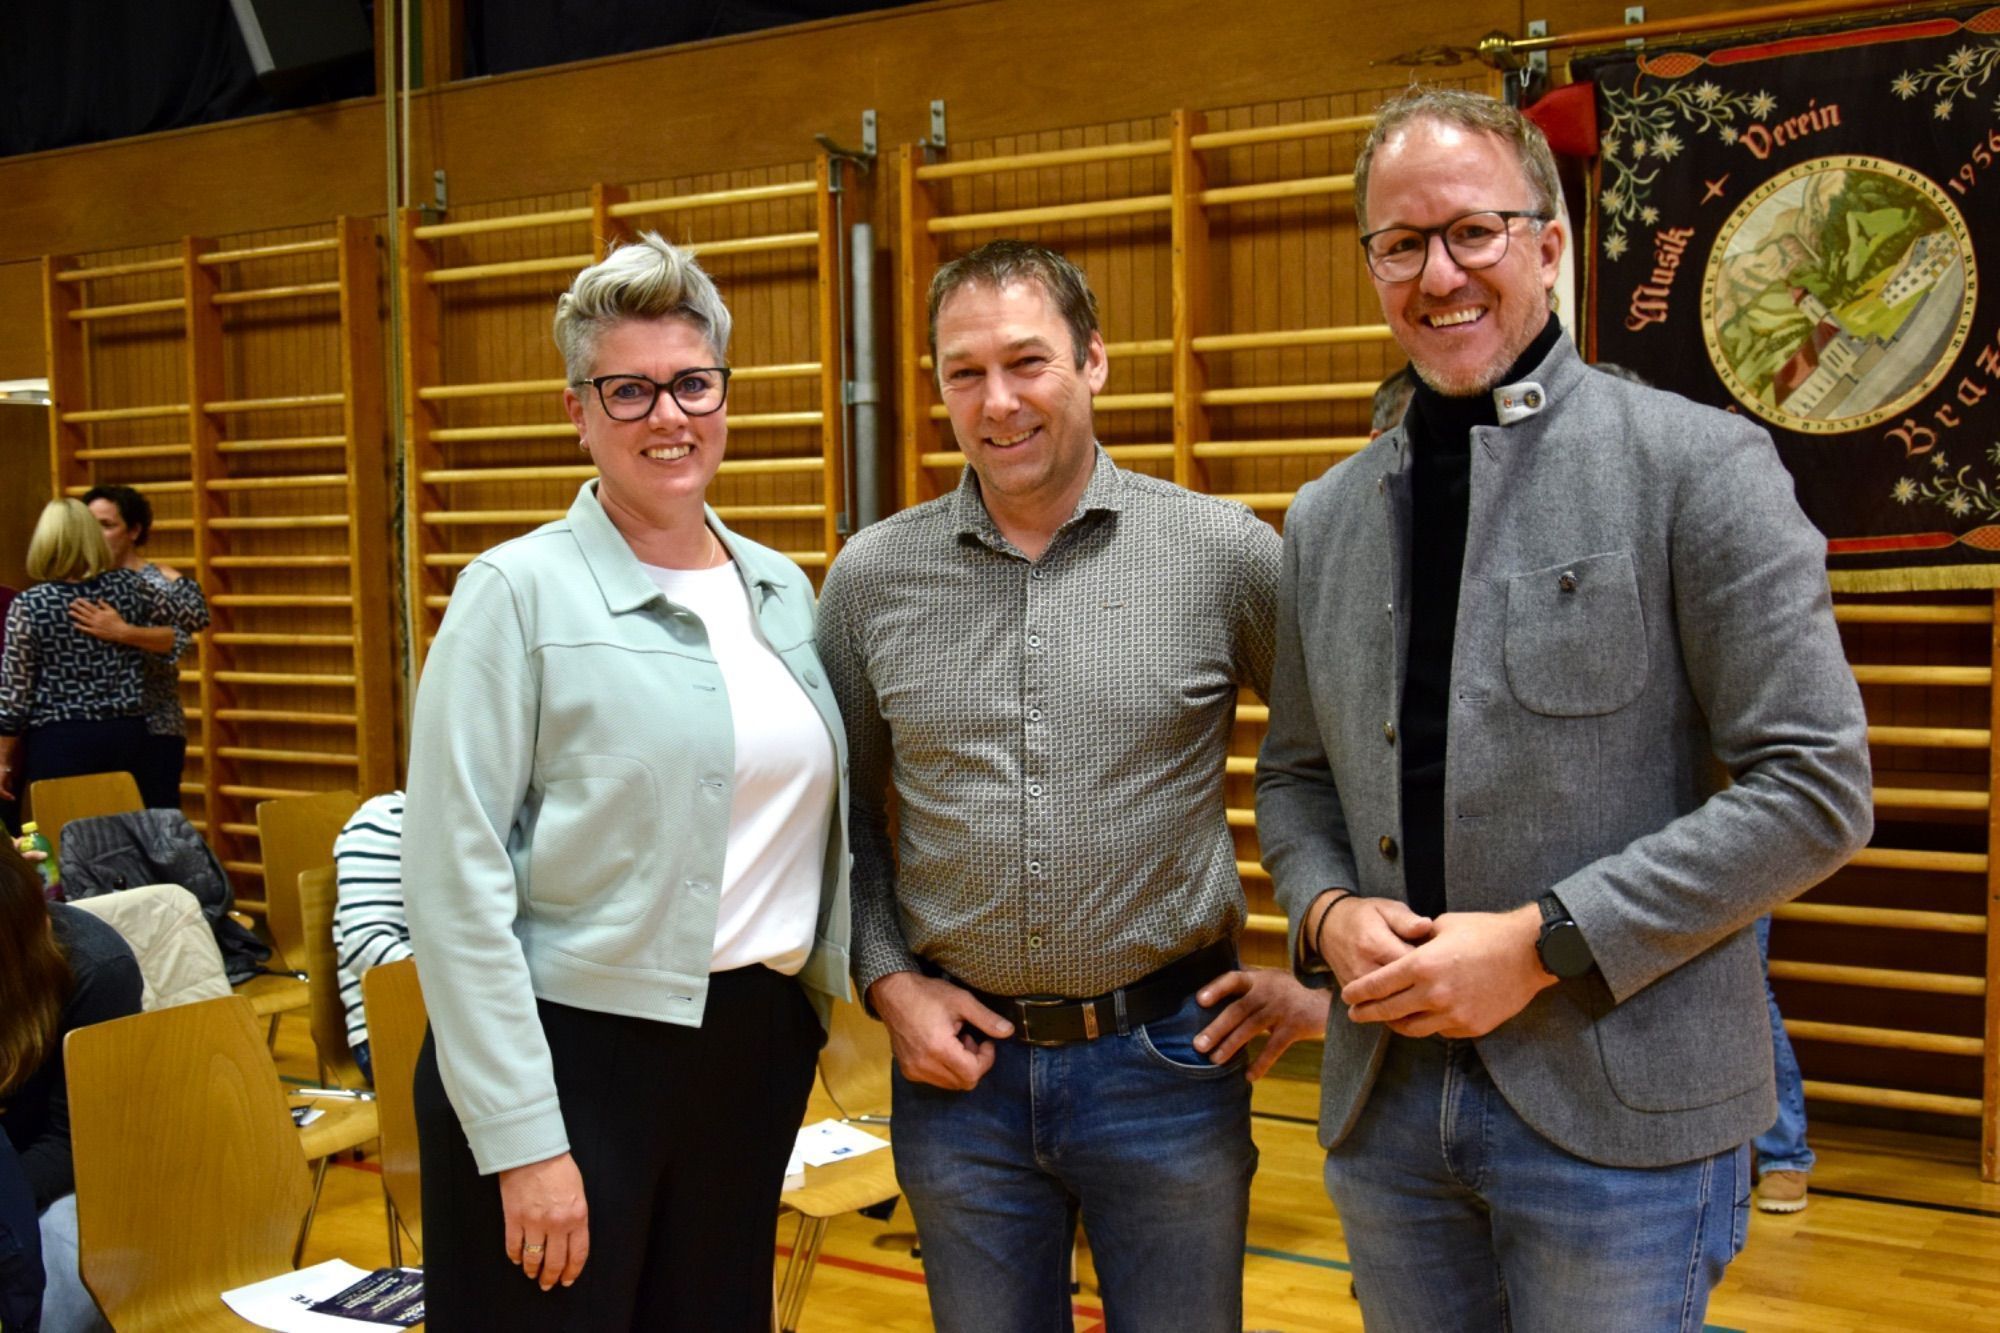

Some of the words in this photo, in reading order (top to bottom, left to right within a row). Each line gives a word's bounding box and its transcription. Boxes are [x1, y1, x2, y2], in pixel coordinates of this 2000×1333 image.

[1789, 159, 1830, 176] UND
[1948, 128, 2000, 195] 1956
[1625, 225, 1696, 332] Musik
[1739, 99, 1841, 160] Verein
[1711, 182, 1777, 265] DIETRICH
[1896, 167, 1966, 240] FRANZISKA
[1704, 276, 1714, 320] KARL
[1706, 337, 1746, 399] FAHNE
[1884, 328, 2000, 458] Braz
[1755, 404, 1787, 425] DER
[1800, 412, 1883, 431] SPENDER
